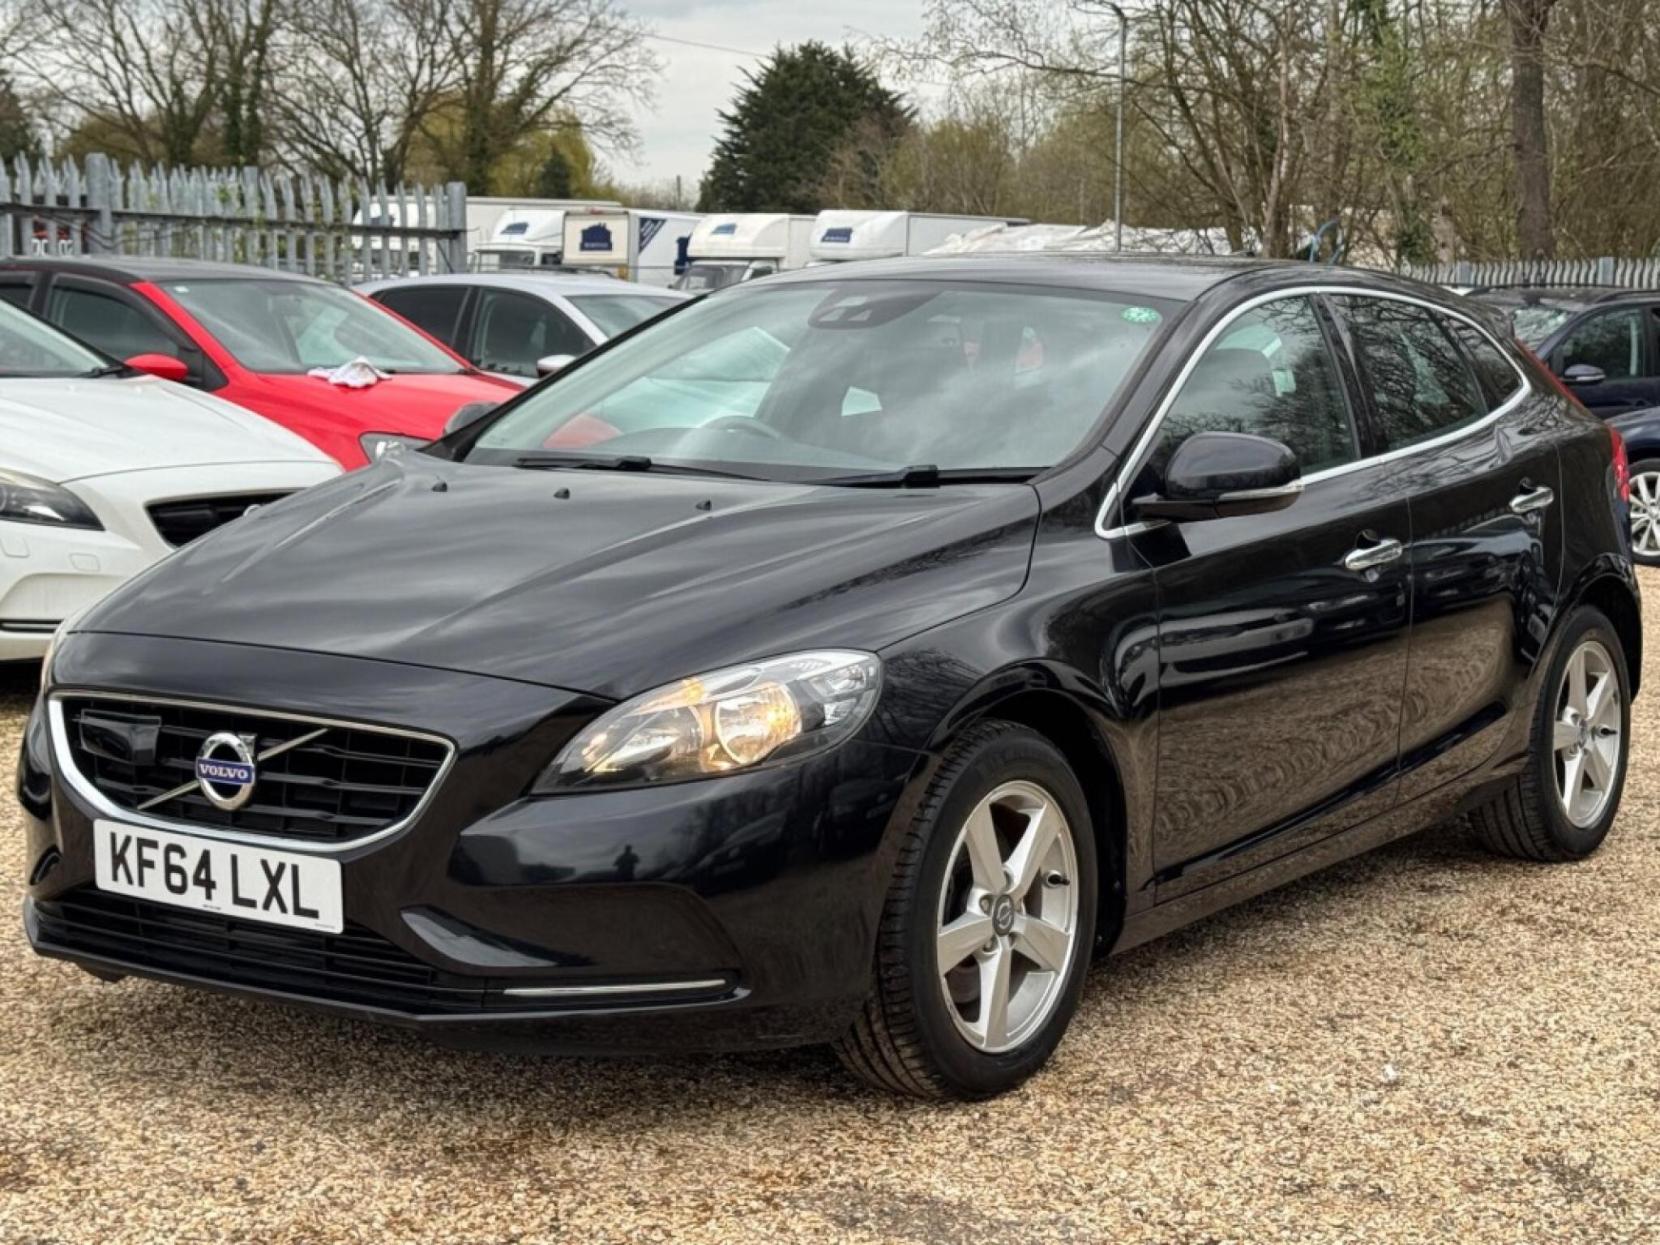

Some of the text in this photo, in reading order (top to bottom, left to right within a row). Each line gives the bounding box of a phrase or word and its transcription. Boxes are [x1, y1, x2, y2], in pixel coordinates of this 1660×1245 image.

[200, 763, 248, 779] VOLVO
[110, 831, 319, 920] KF64 LXL
